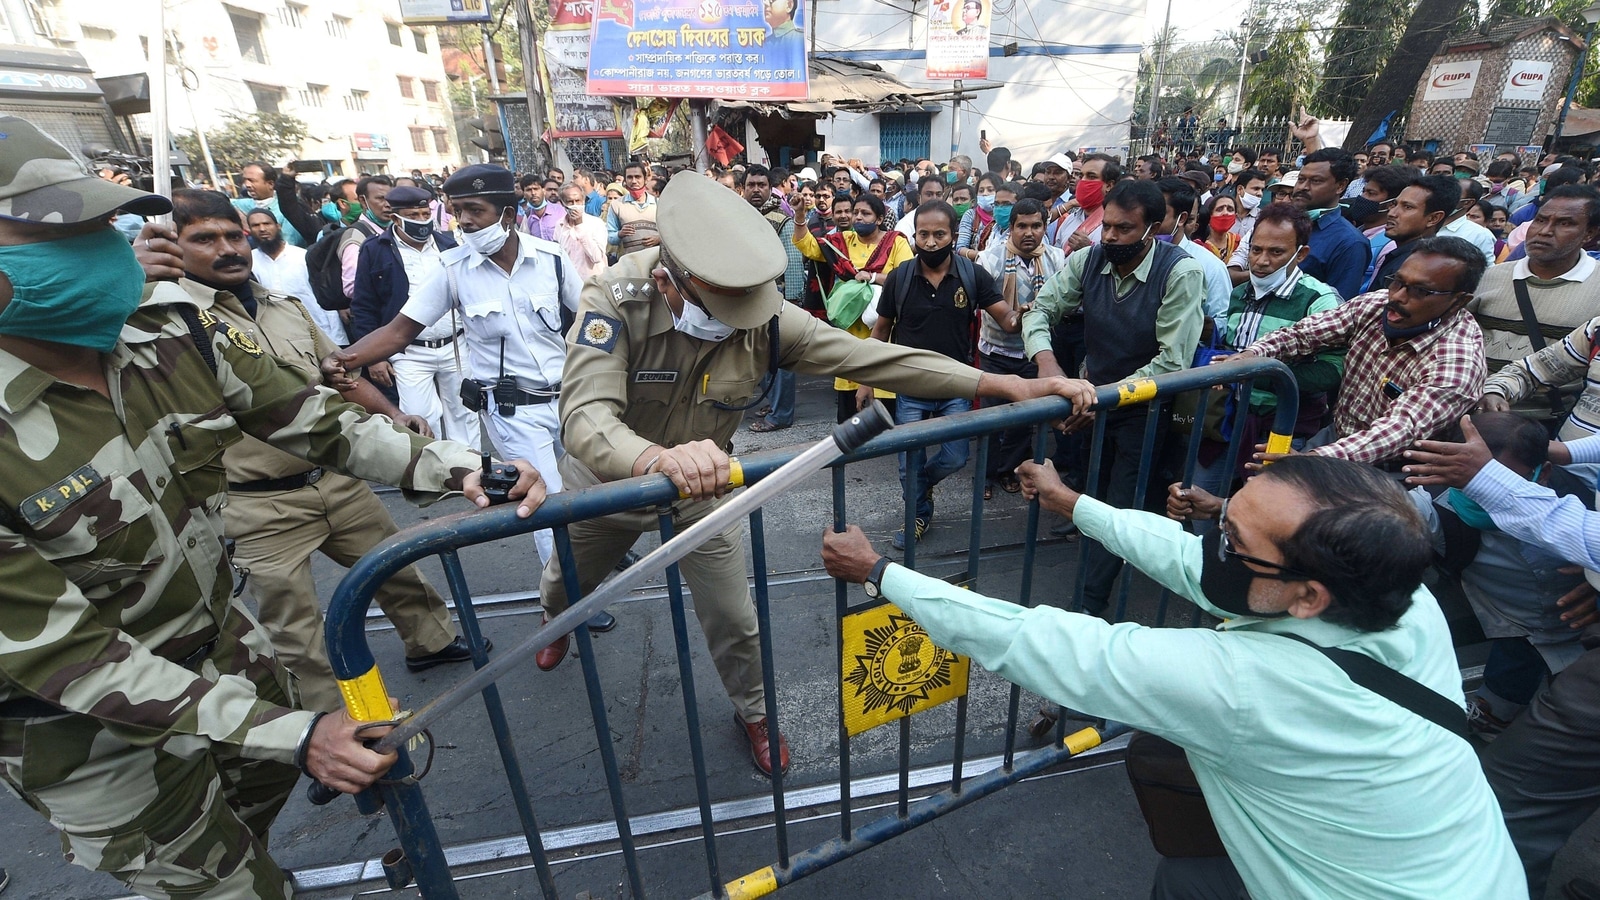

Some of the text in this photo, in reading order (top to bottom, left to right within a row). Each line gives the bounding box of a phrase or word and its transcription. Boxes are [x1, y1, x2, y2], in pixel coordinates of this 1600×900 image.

[464, 0, 482, 10] LIC
[700, 3, 721, 19] ১২৫
[627, 23, 766, 48] দেশপ্রেম দিবসের ডাক
[635, 51, 682, 63] সাম্প্রদায়িক
[684, 51, 716, 64] শক্তিকে
[719, 53, 743, 64] পরাস্ত
[600, 65, 654, 78] কোম্পানীরাজ
[675, 69, 712, 79] জনগণের
[715, 67, 752, 79] ভারতবর্ষ
[753, 69, 772, 81] গড়ে
[1443, 72, 1471, 81] RUPA
[1520, 73, 1543, 81] RUPA
[628, 83, 770, 96] সারা ভারত ফরওয়ার্ড ব্লক
[36, 474, 93, 512] K. PAL
[873, 635, 898, 686] KOLKATA
